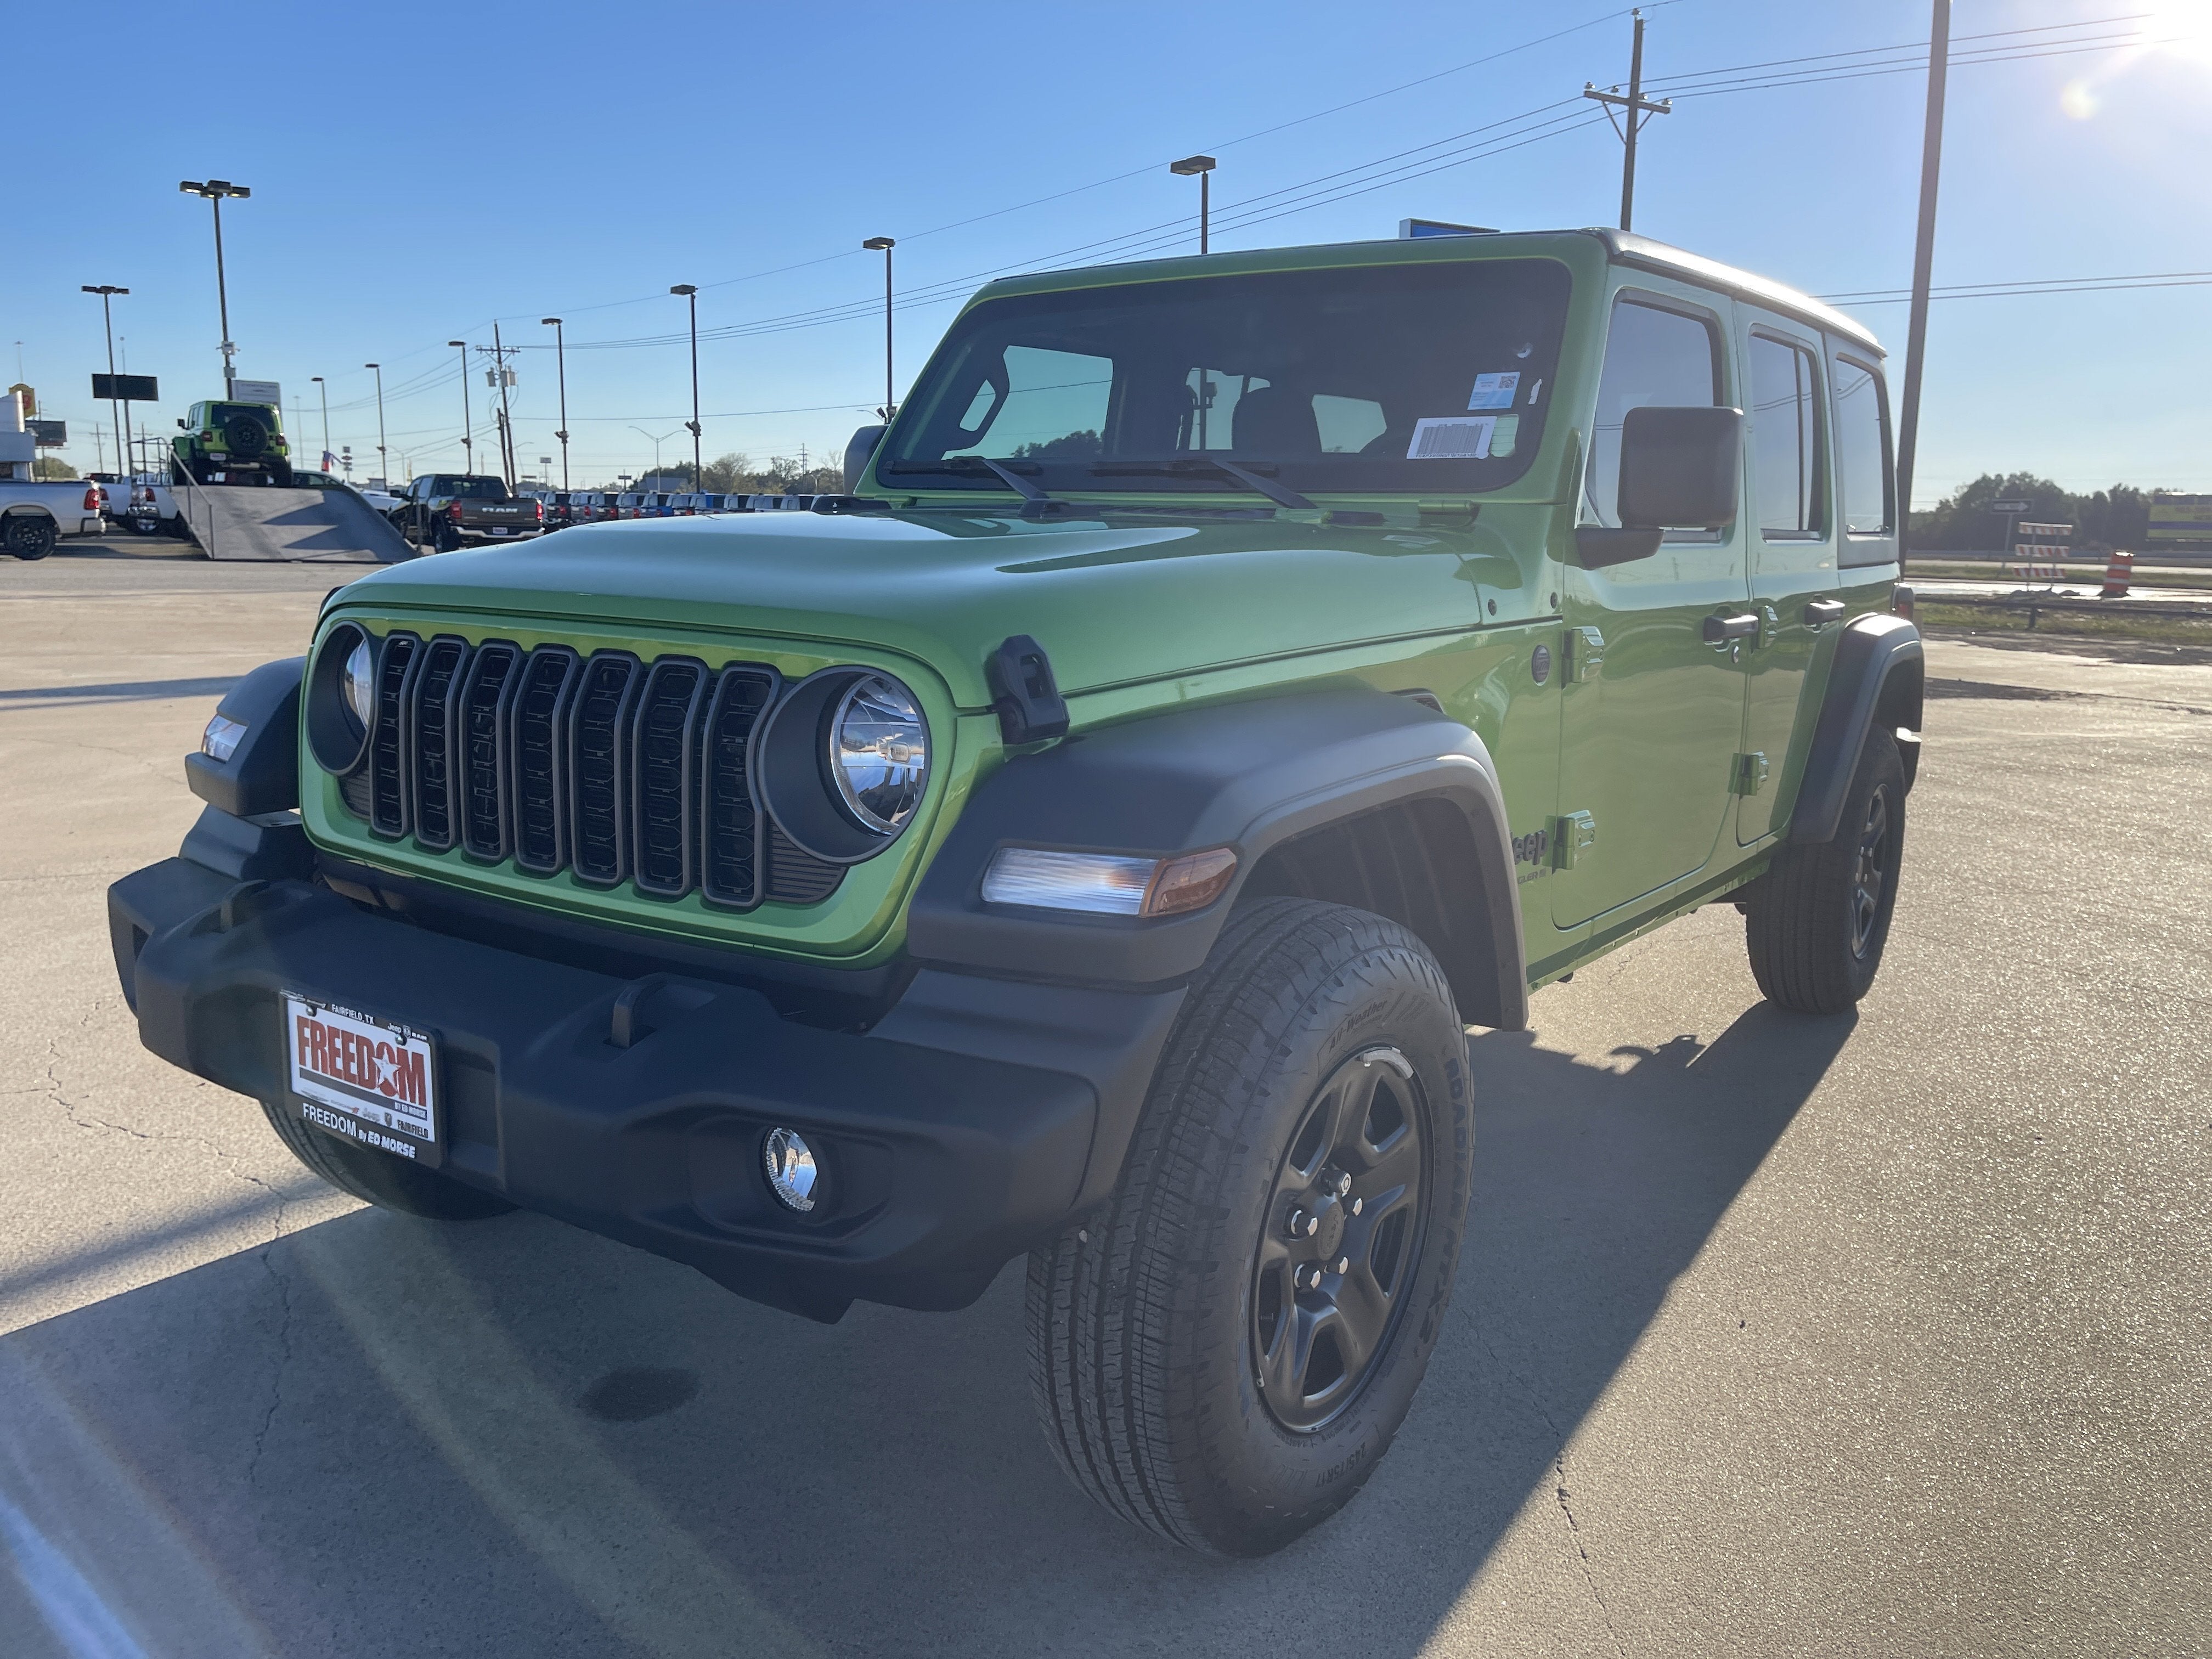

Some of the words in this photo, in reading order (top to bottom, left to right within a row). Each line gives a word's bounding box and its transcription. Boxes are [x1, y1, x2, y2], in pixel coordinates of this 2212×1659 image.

[1510, 830, 1548, 865] eep
[331, 1004, 365, 1023] FAIRFIELD,
[365, 1014, 375, 1025] TX
[297, 1015, 427, 1107] FREEDOM
[303, 1103, 357, 1137] FREEDOM
[368, 1131, 380, 1145] ED
[381, 1137, 416, 1159] MORSE
